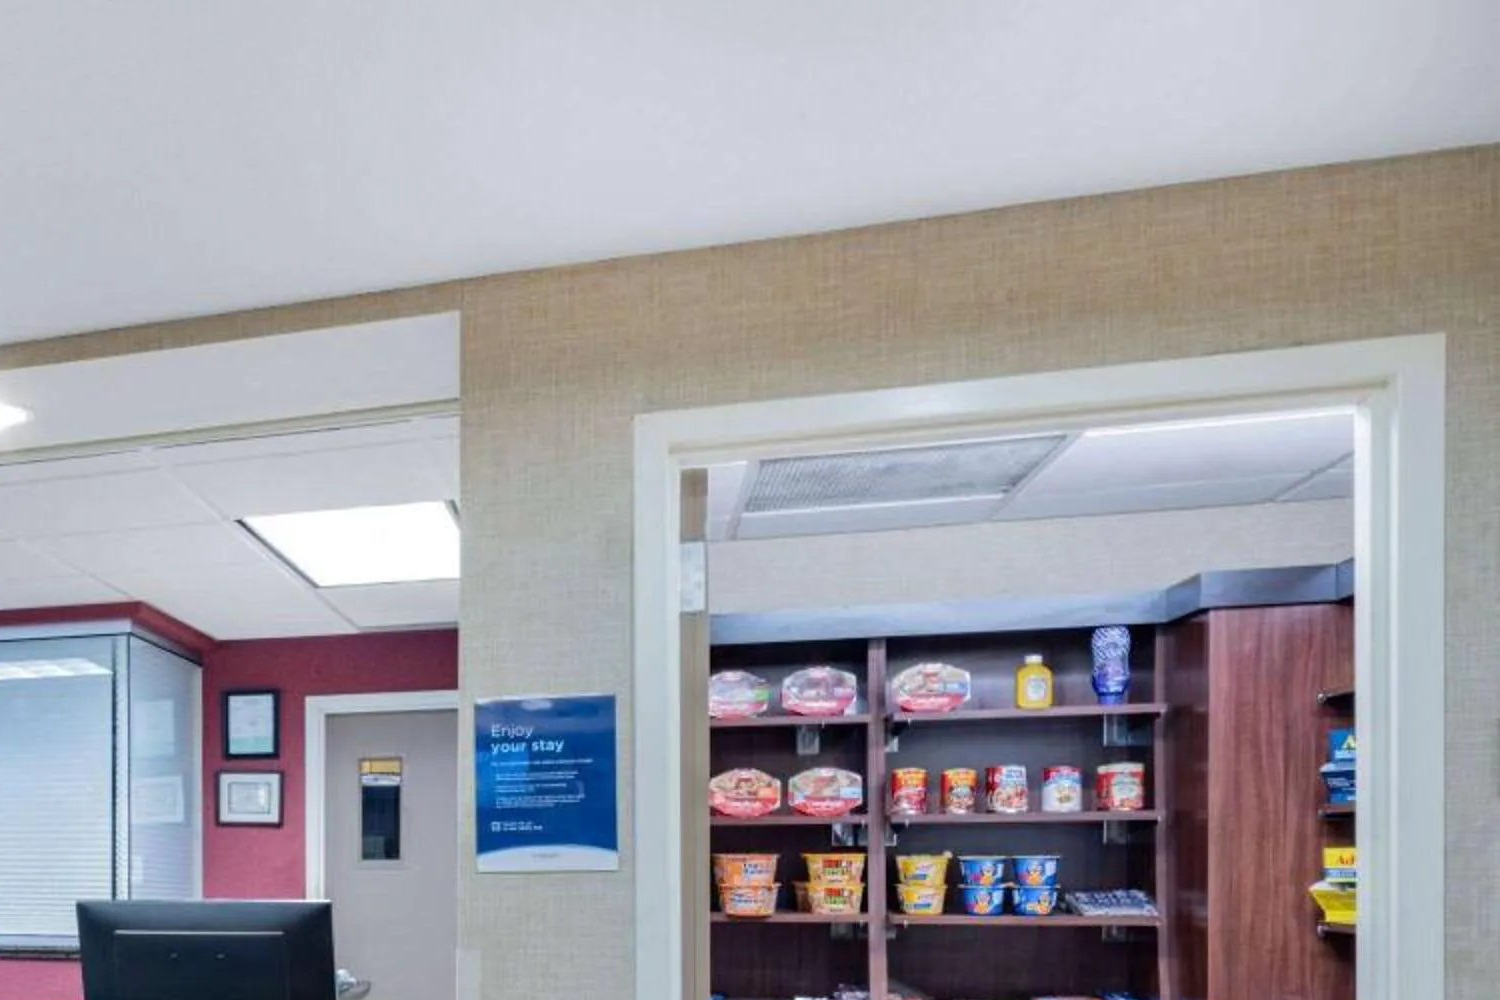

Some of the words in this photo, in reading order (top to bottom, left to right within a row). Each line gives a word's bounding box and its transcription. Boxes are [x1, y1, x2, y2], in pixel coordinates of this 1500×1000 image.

[491, 723, 534, 739] Enjoy
[490, 742, 527, 755] your
[531, 739, 564, 753] stay
